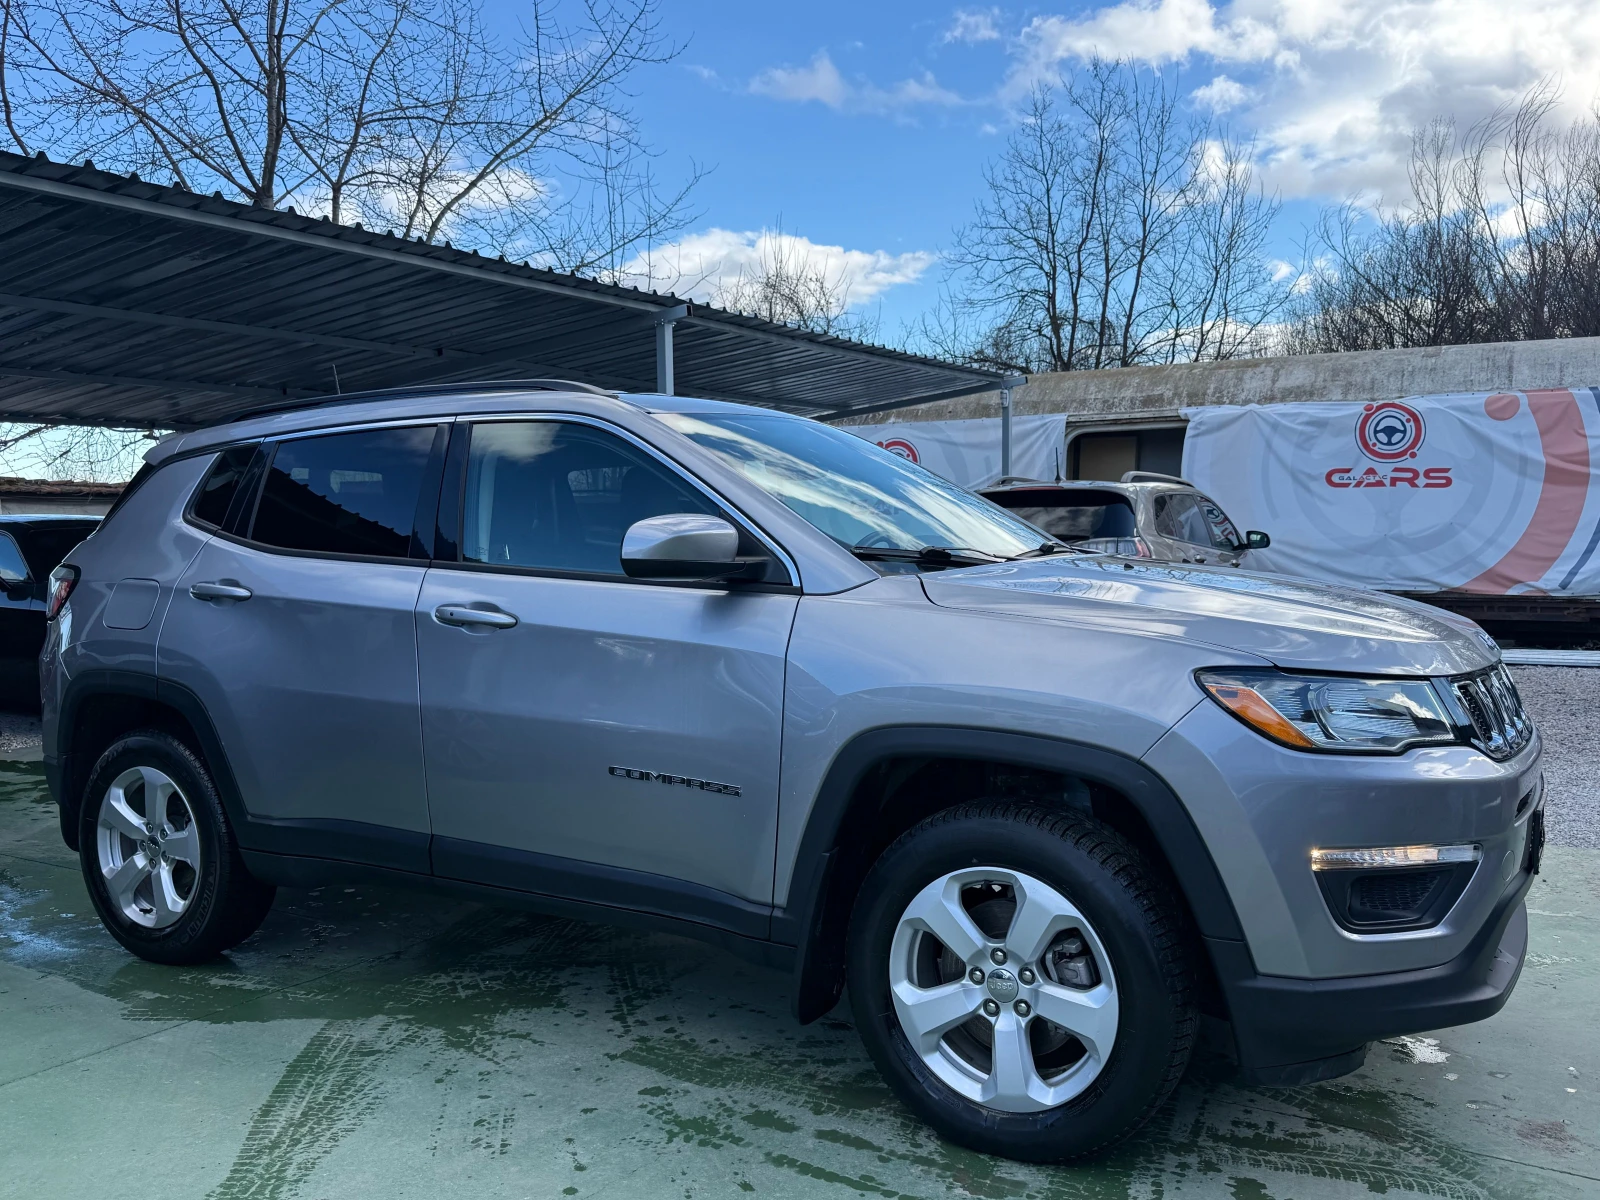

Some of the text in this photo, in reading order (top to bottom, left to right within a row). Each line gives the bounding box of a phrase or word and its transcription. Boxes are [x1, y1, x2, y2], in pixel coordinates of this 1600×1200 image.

[1325, 466, 1453, 489] CARS
[608, 765, 743, 798] COMPASS
[990, 980, 1014, 990] Jeep
